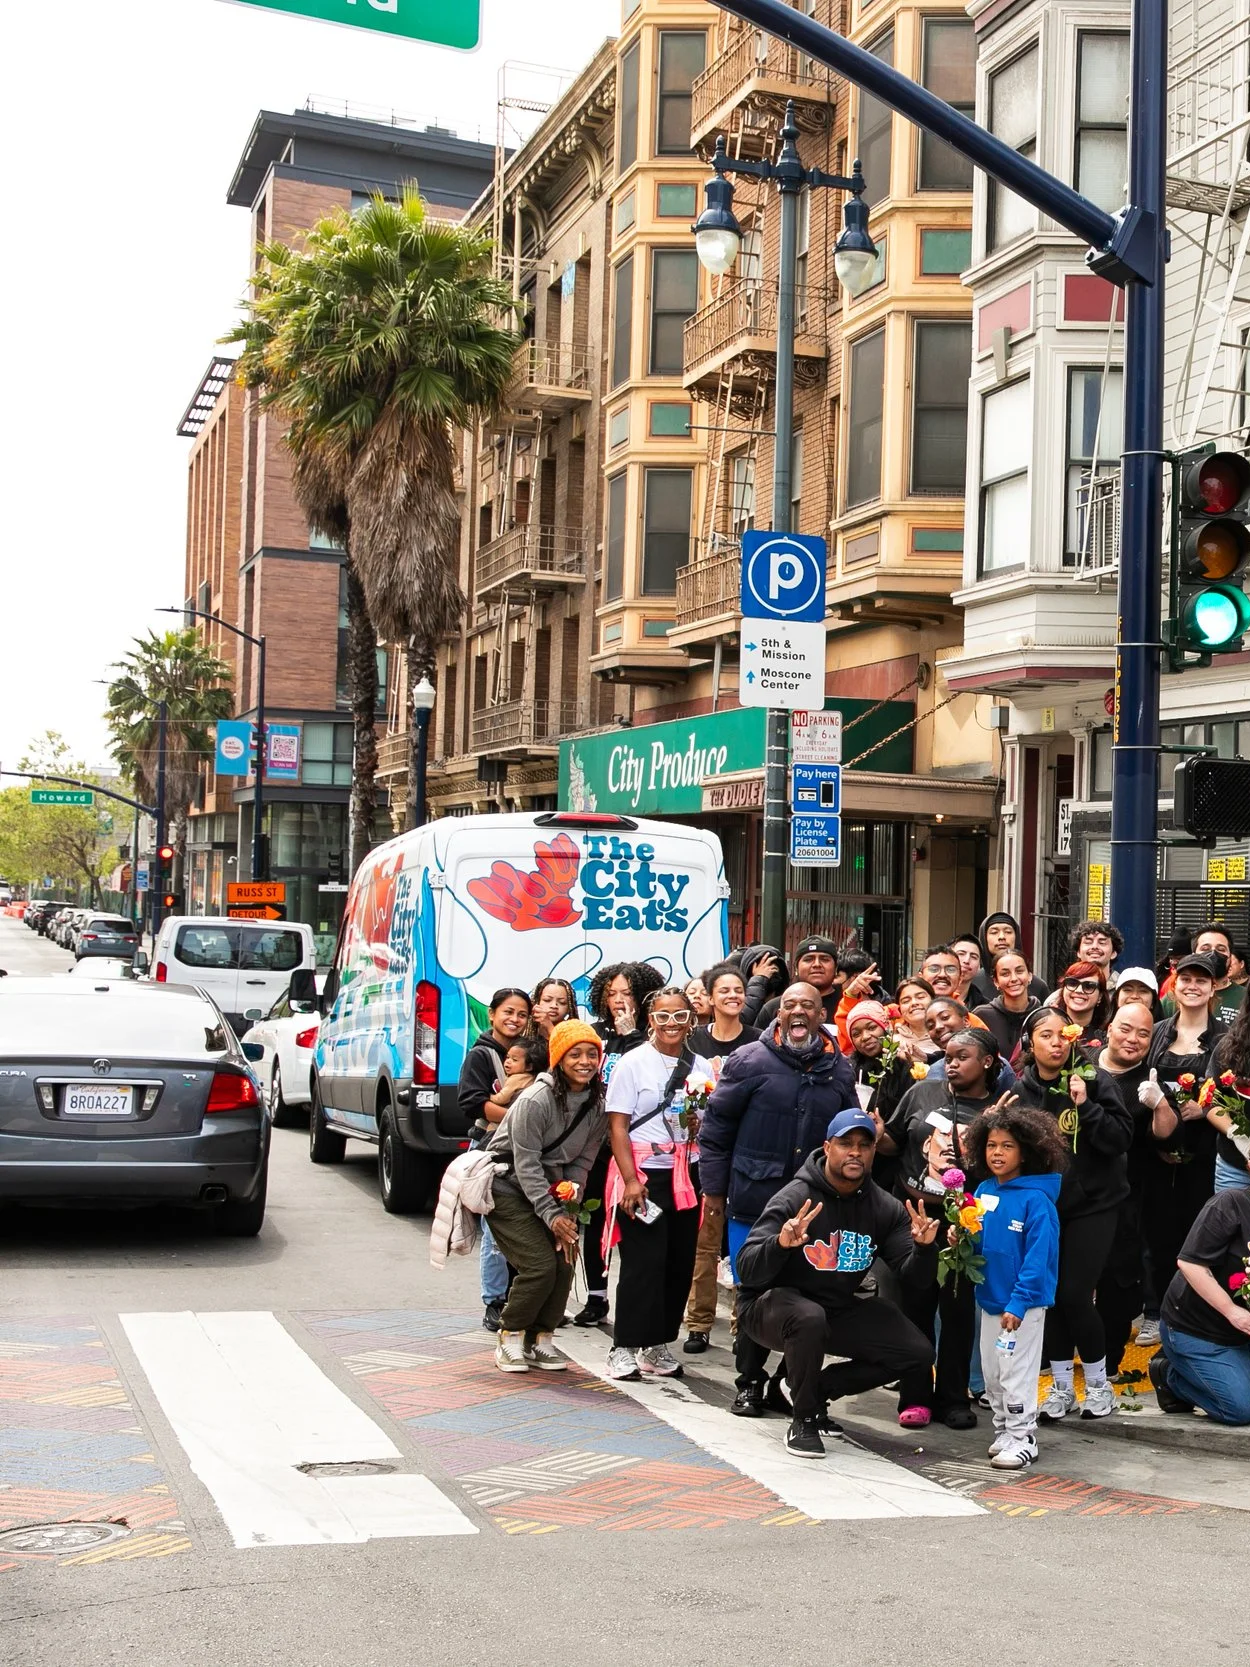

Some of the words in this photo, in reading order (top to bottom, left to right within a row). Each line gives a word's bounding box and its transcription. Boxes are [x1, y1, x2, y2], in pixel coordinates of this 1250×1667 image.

[769, 553, 804, 600] P
[761, 638, 780, 648] 5th
[784, 639, 791, 649] &
[762, 650, 806, 661] Mission
[760, 668, 812, 680] Moscone
[761, 679, 800, 690] Center
[793, 712, 807, 726] NO
[809, 715, 840, 727] PARKING
[607, 744, 644, 808] City
[647, 732, 728, 791] Produce
[796, 768, 814, 780] Pay
[815, 768, 838, 779] here
[39, 793, 86, 802] Howard
[795, 818, 812, 828] Pay
[814, 818, 826, 829] by
[795, 828, 828, 837] License
[795, 837, 818, 846] Plate
[583, 835, 655, 861] The
[797, 849, 834, 857] 20601004
[397, 876, 411, 899] The
[580, 861, 690, 909] City
[236, 887, 263, 897] RUSS
[266, 887, 277, 897] ST
[231, 910, 268, 919] DETOUR
[582, 897, 689, 933] Eats
[392, 900, 414, 945] City
[843, 1231, 870, 1244] The
